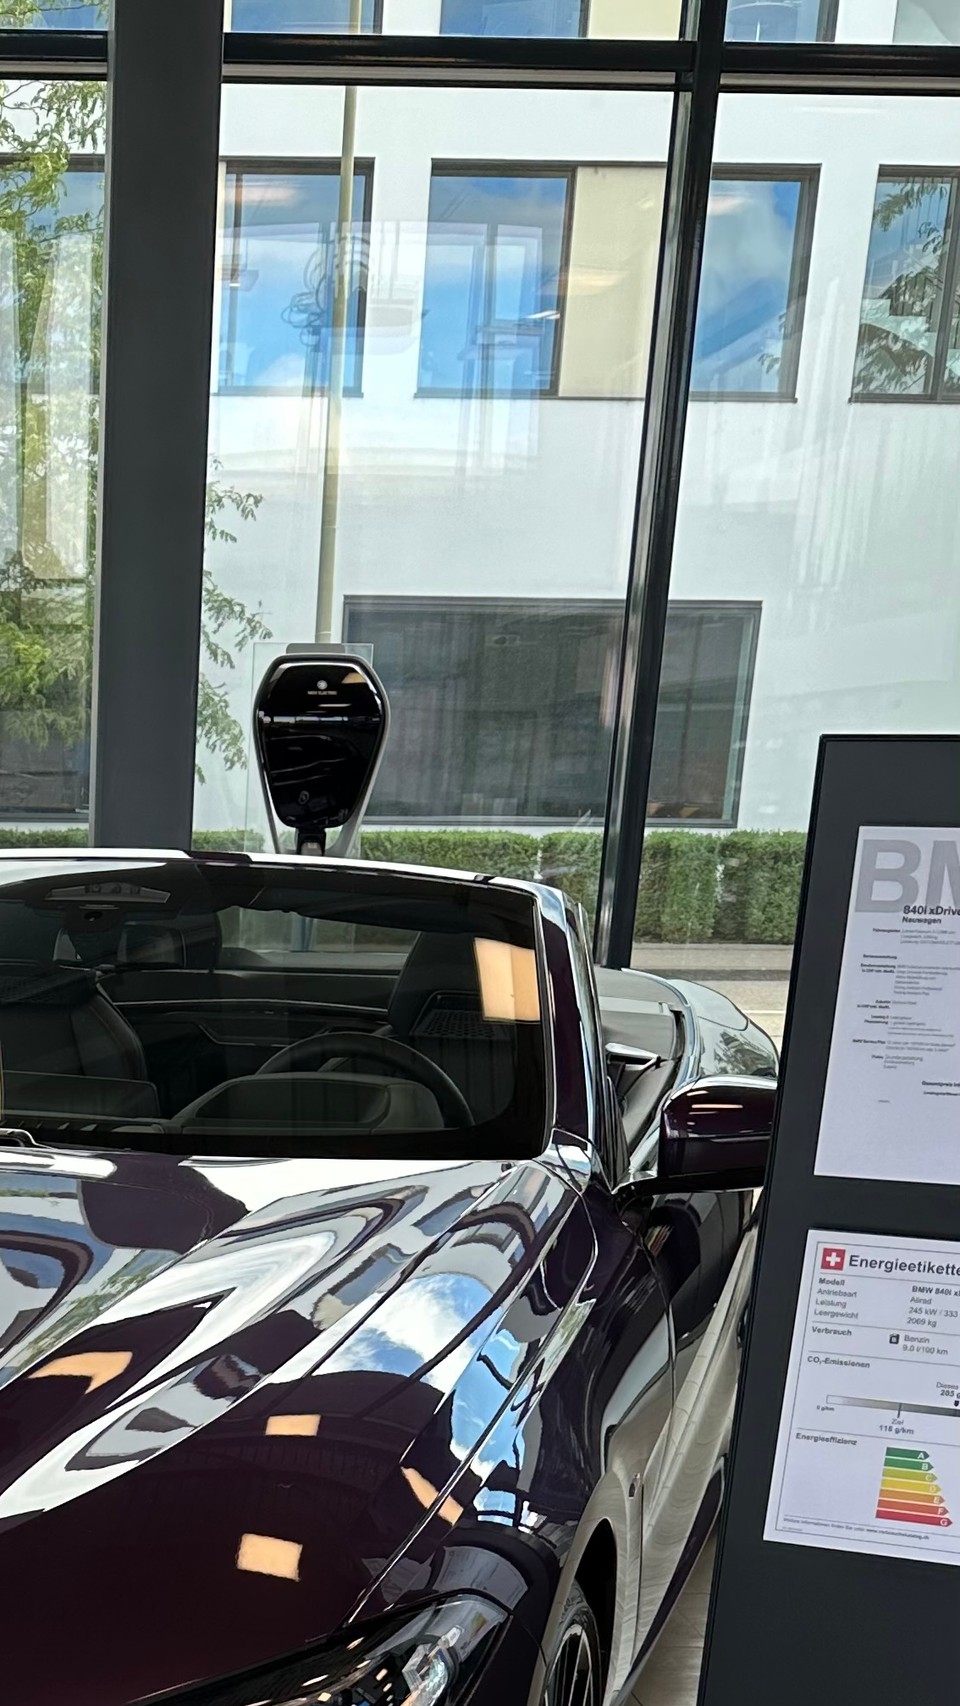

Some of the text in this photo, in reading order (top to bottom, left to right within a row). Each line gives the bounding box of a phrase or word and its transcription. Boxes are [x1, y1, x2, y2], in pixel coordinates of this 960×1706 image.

[903, 905, 927, 915] 840i
[902, 916, 942, 925] Neuwagen
[848, 1254, 960, 1277] Energieetikette
[818, 1277, 845, 1286] Modell
[912, 1285, 934, 1294] BMW
[934, 1287, 952, 1296] 840i
[817, 1287, 932, 1305] Antriebsart Allrad
[815, 1298, 847, 1309] Leistung
[908, 1306, 923, 1314] 245
[924, 1308, 938, 1316] kW
[943, 1309, 958, 1318] 333
[814, 1309, 859, 1320] Leergewicht
[927, 1319, 937, 1328] kg
[811, 1325, 930, 1344] Verbrauch Benzin
[936, 1347, 949, 1355] km
[894, 1427, 915, 1435] g/km
[795, 1432, 858, 1446] Energieeffizienz
[917, 1452, 925, 1460] A
[929, 1485, 936, 1493] D
[933, 1496, 940, 1504] E
[937, 1507, 944, 1515] F
[940, 1518, 948, 1527] G
